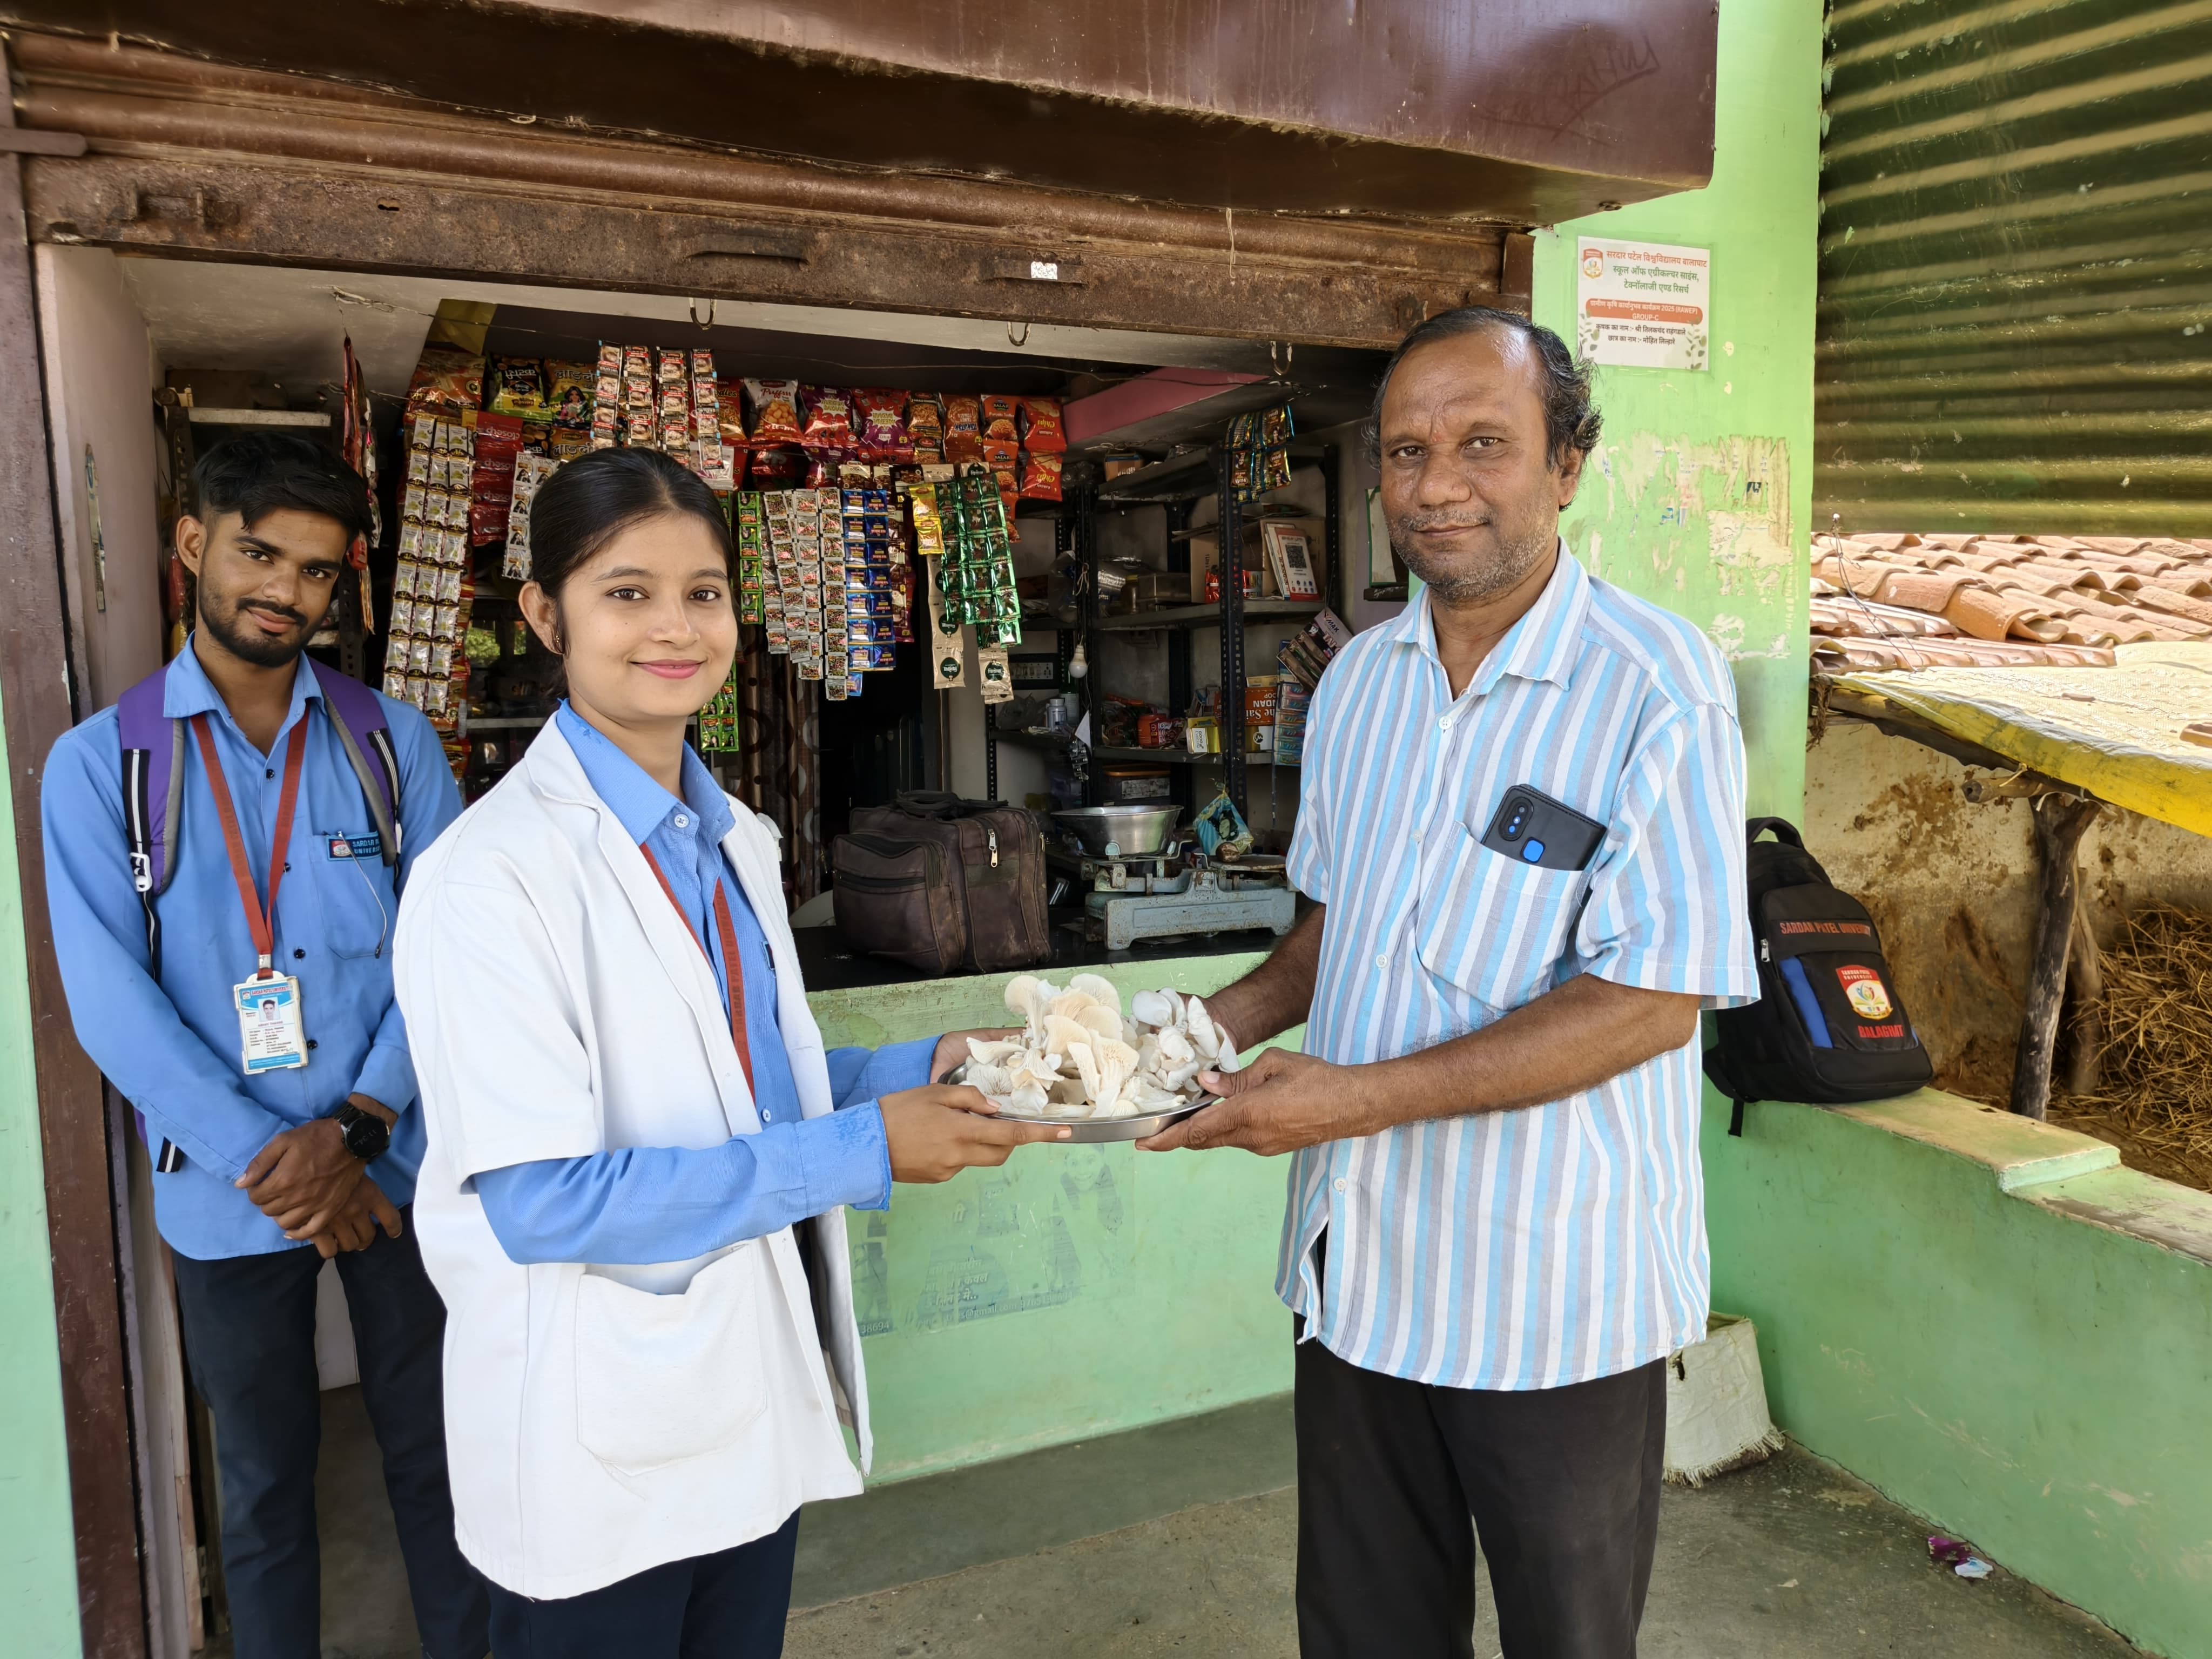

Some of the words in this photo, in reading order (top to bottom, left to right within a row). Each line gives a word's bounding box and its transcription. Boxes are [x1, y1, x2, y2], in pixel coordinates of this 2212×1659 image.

[1606, 251, 1626, 259] सरदार
[1628, 251, 1642, 260] पटेल
[1643, 252, 1682, 264] विश्वविद्यालय
[1613, 266, 1629, 276] स्कूल
[1631, 266, 1646, 275] ऑफ
[1648, 266, 1678, 278] एग्रीकल्चर
[1658, 284, 1672, 293] एण्ड
[1673, 283, 1689, 294] रिसर्च
[1642, 325, 1665, 334] तिलकचंद
[1643, 335, 1657, 345] मोहित
[1037, 419, 1055, 428] Chips
[486, 427, 521, 440] closeup
[484, 458, 515, 470] loseup
[1246, 709, 1262, 720] Sai
[352, 839, 374, 847] SARDAR
